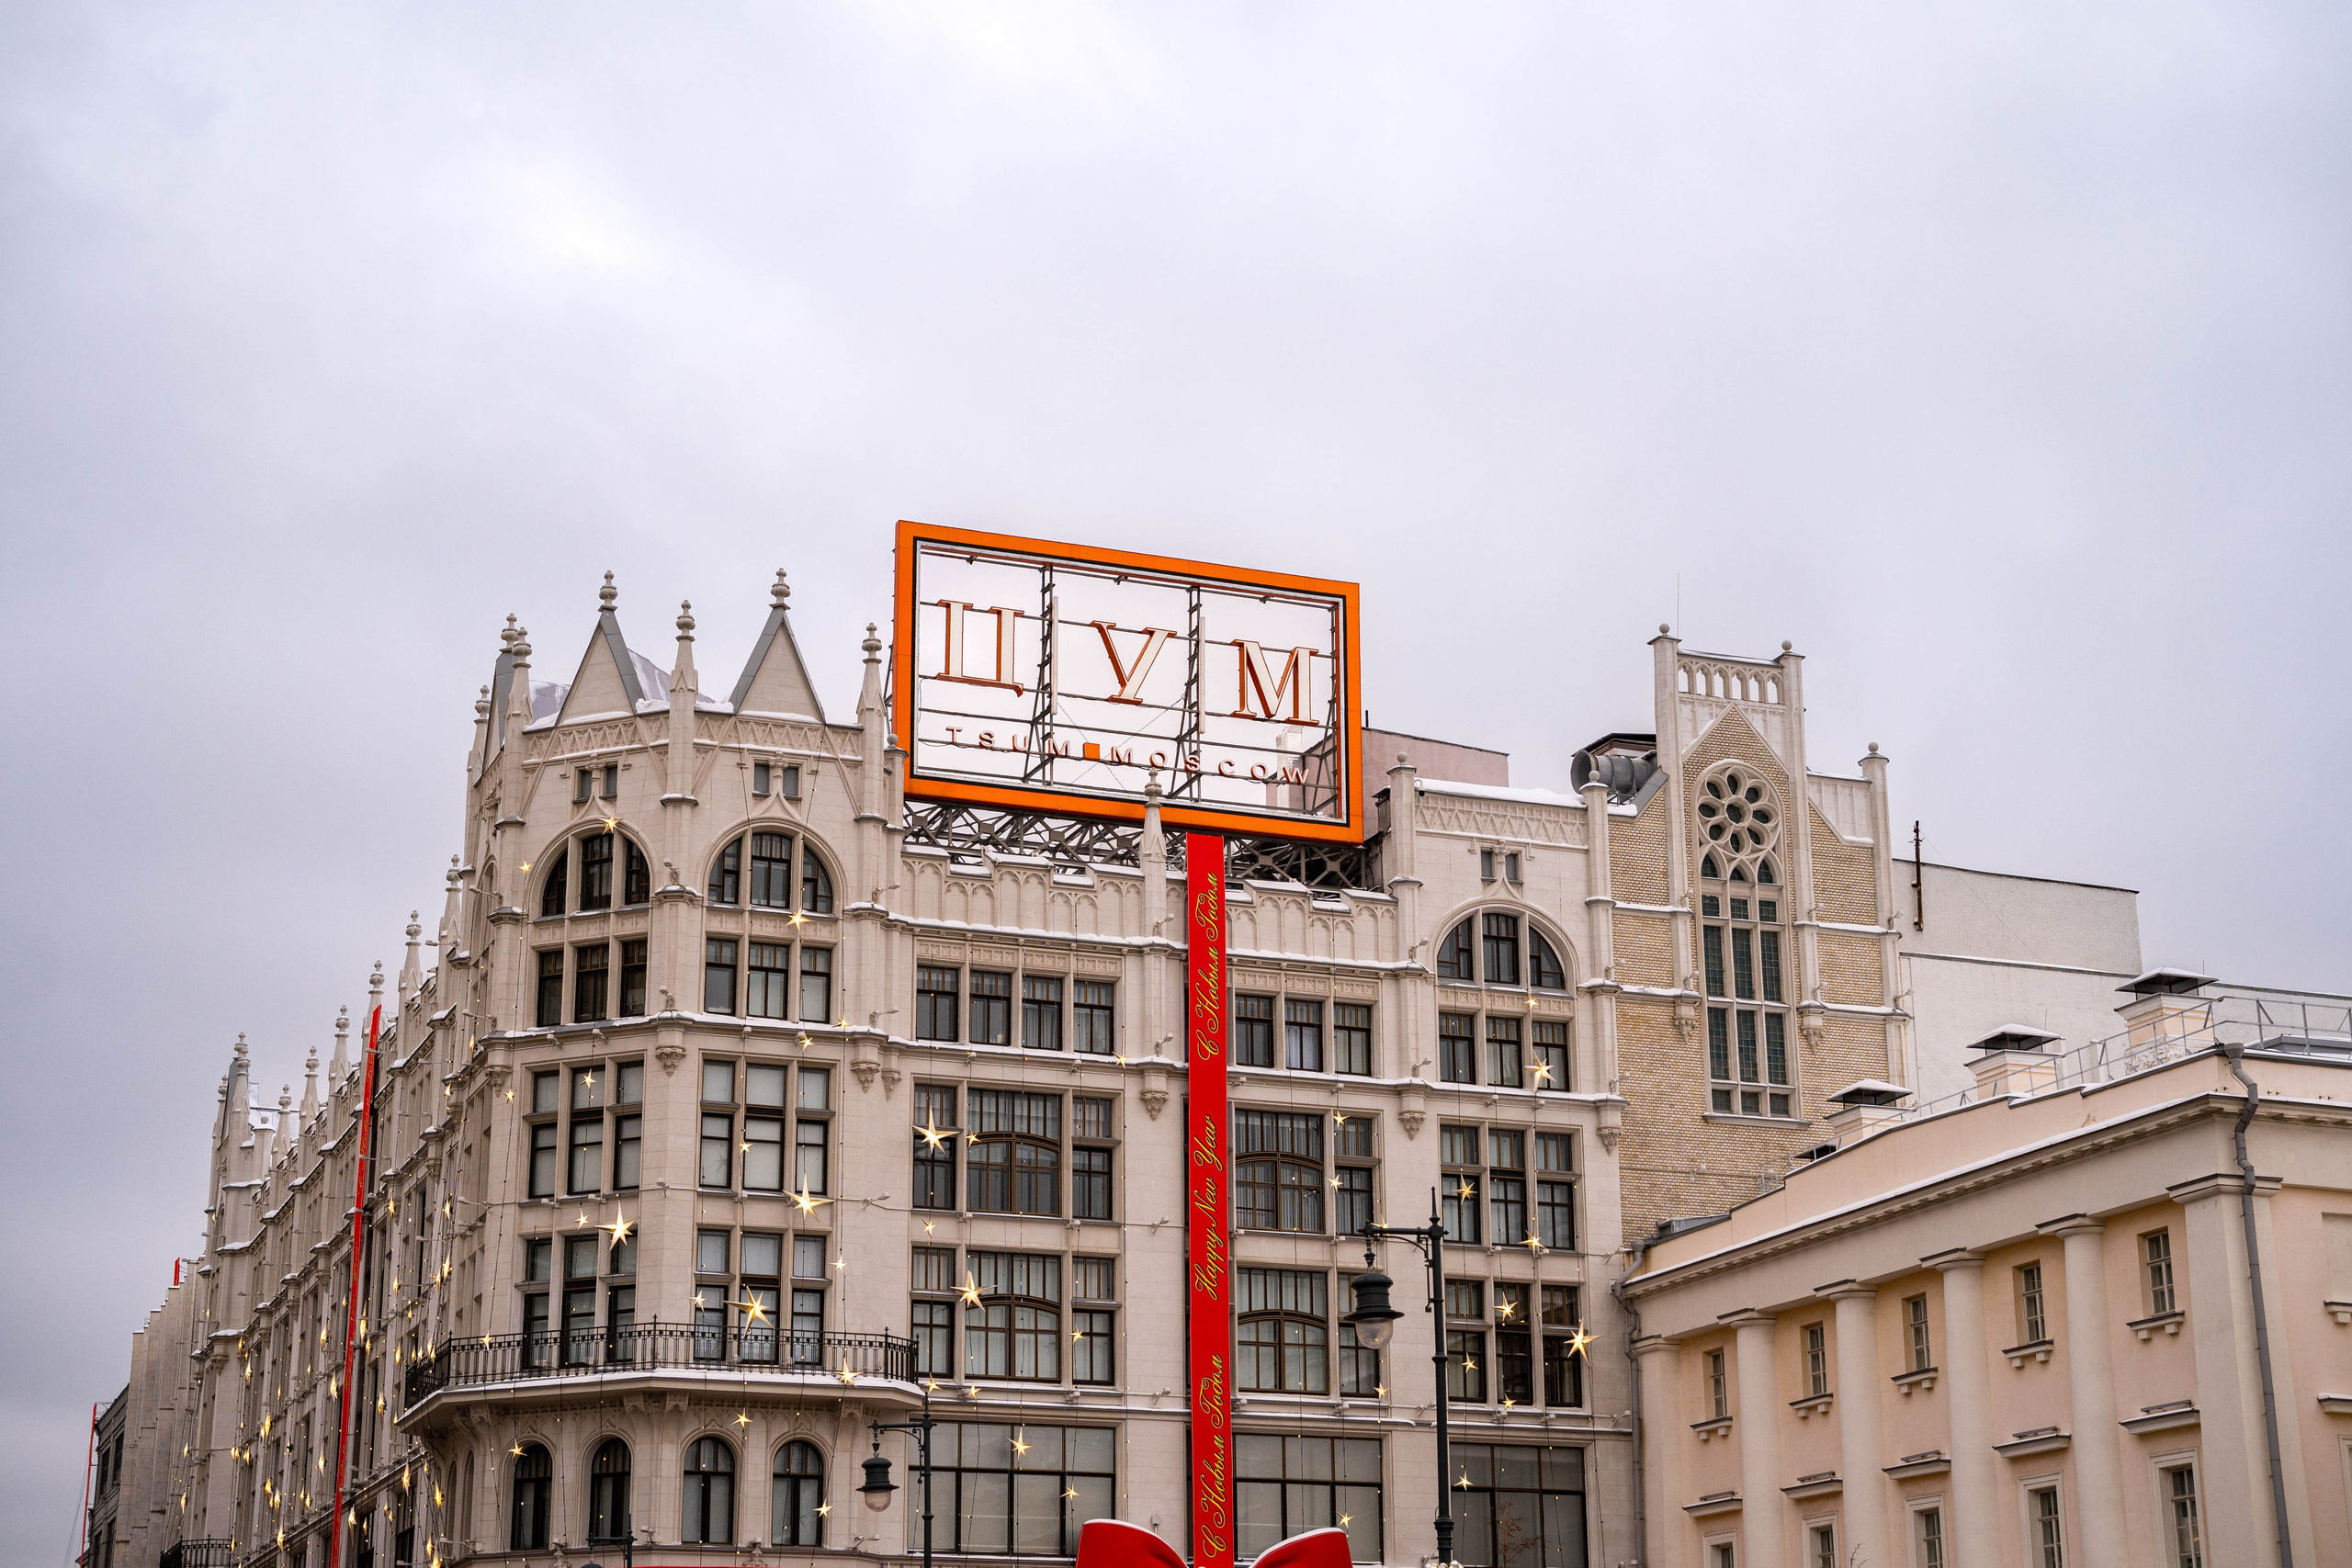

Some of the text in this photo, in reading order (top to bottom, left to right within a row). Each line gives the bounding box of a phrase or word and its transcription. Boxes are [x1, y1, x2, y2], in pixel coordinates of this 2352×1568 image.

[935, 599, 1320, 727] ЦУМ
[945, 726, 1309, 784] TSUM MOSCOW
[1195, 872, 1219, 942] Годом
[1195, 946, 1220, 1033] Новым
[1193, 1114, 1225, 1301] Happy New Year
[1199, 1353, 1225, 1429] Годом
[1201, 1434, 1227, 1529] Новым
